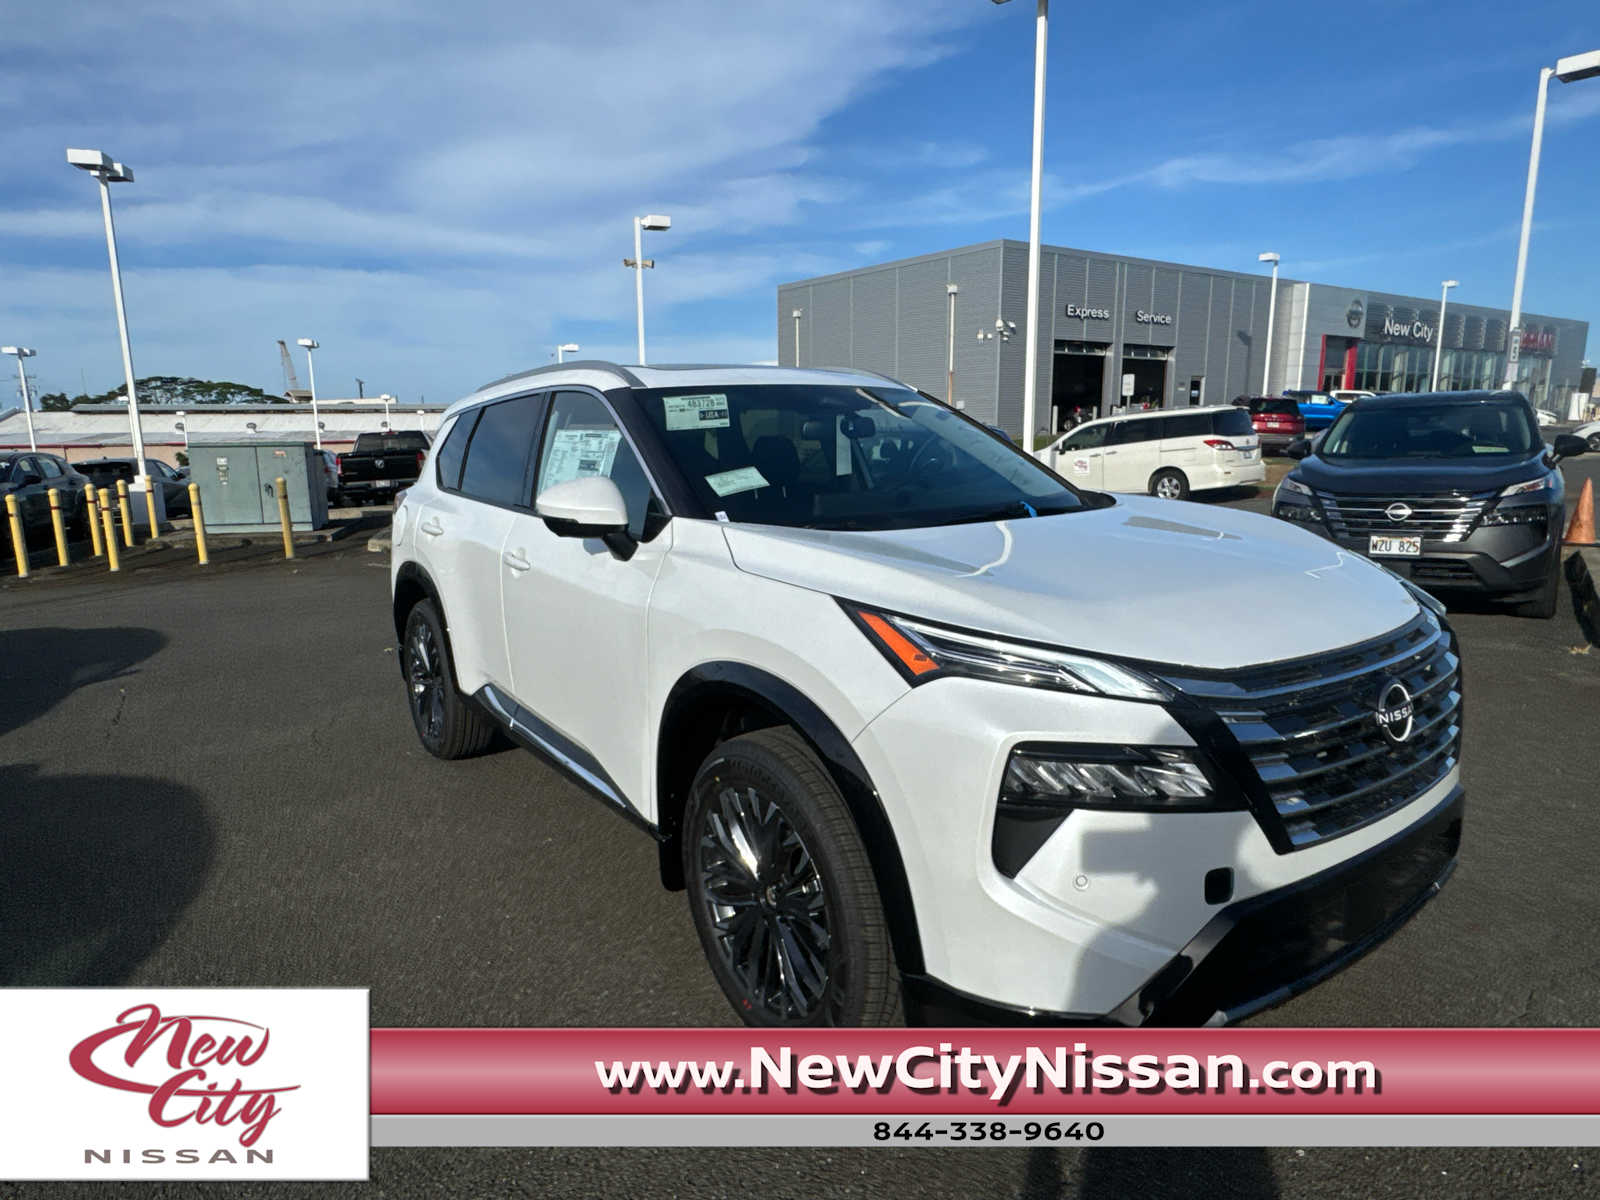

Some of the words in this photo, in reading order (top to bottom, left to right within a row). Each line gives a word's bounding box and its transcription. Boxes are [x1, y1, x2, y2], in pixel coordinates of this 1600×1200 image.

[1066, 304, 1110, 319] Express
[1136, 310, 1172, 324] Service
[1384, 318, 1410, 337] New
[1413, 321, 1433, 342] City
[1398, 540, 1419, 553] 825
